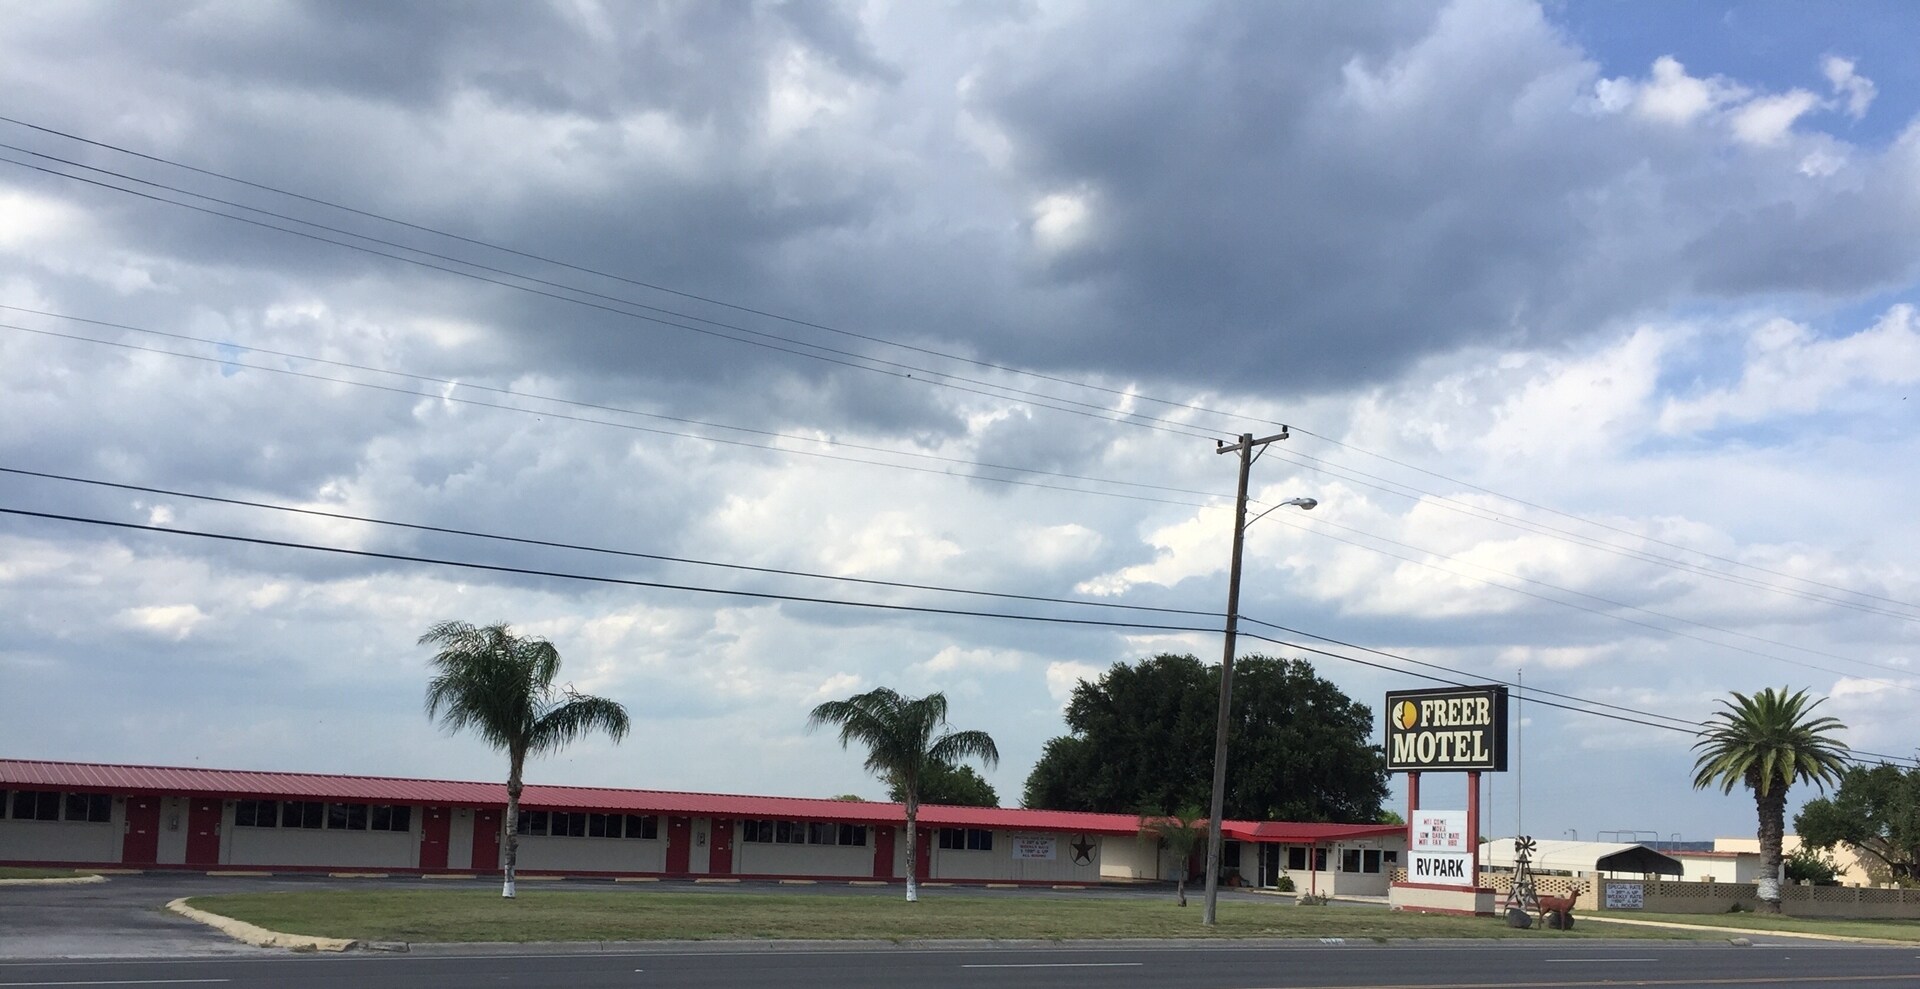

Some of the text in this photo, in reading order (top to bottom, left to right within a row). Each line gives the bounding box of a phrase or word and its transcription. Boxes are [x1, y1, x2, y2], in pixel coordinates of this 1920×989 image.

[1420, 697, 1491, 727] FREER
[1392, 730, 1489, 763] MOTEL
[1416, 858, 1464, 877] RV PARK
